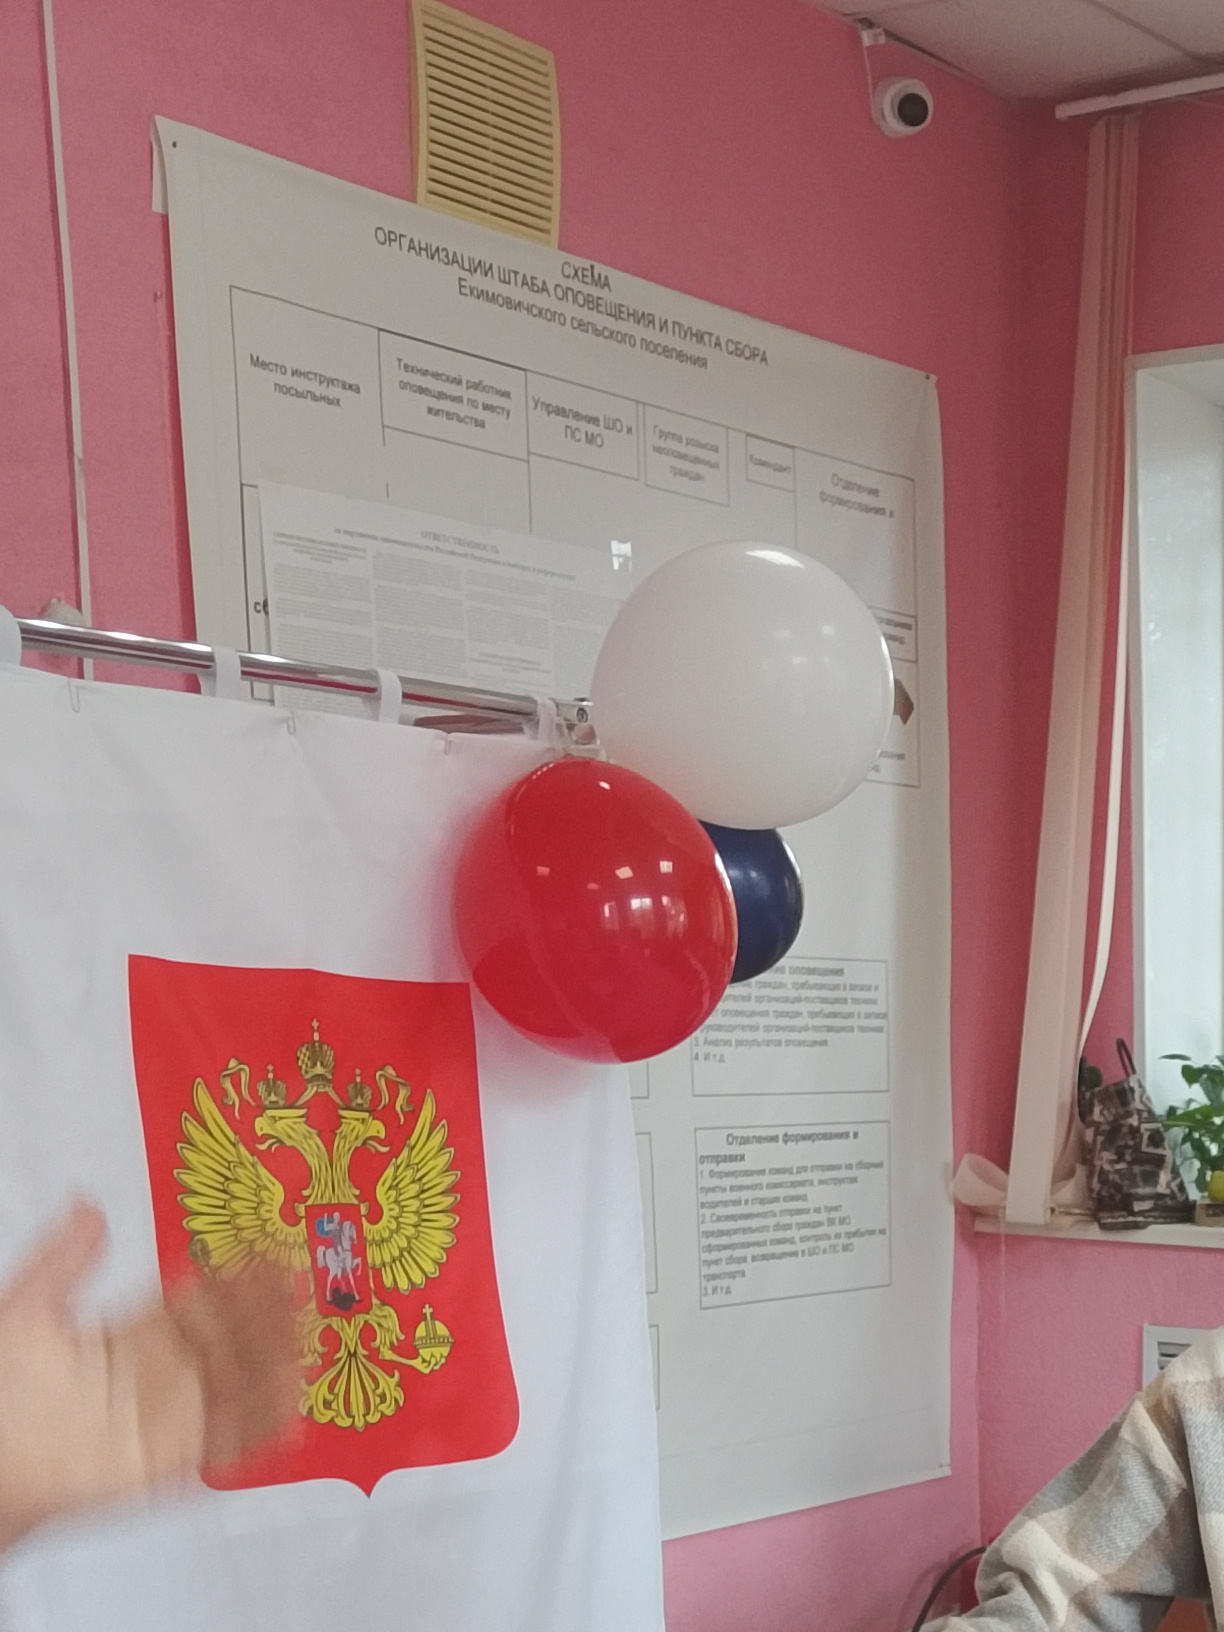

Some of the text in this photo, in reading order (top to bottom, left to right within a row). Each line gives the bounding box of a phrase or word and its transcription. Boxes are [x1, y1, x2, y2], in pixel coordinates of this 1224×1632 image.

[561, 261, 612, 292] СХЕМА
[374, 226, 769, 366] ОРГАНИЗАЦИИ ШТАБА ОПОВЕЩЕНИЯ И ПУНКТА СБОРА
[457, 277, 708, 370] Екимовичского сельского поселения
[250, 353, 361, 395] Место инструктажа
[273, 381, 341, 407] посыльных
[532, 395, 601, 428] Управление
[603, 414, 624, 433] ШО
[564, 424, 604, 449] ПС МО
[726, 1132, 780, 1147] Отделение
[782, 1130, 850, 1146] формирования
[699, 1152, 745, 1166] отправки
